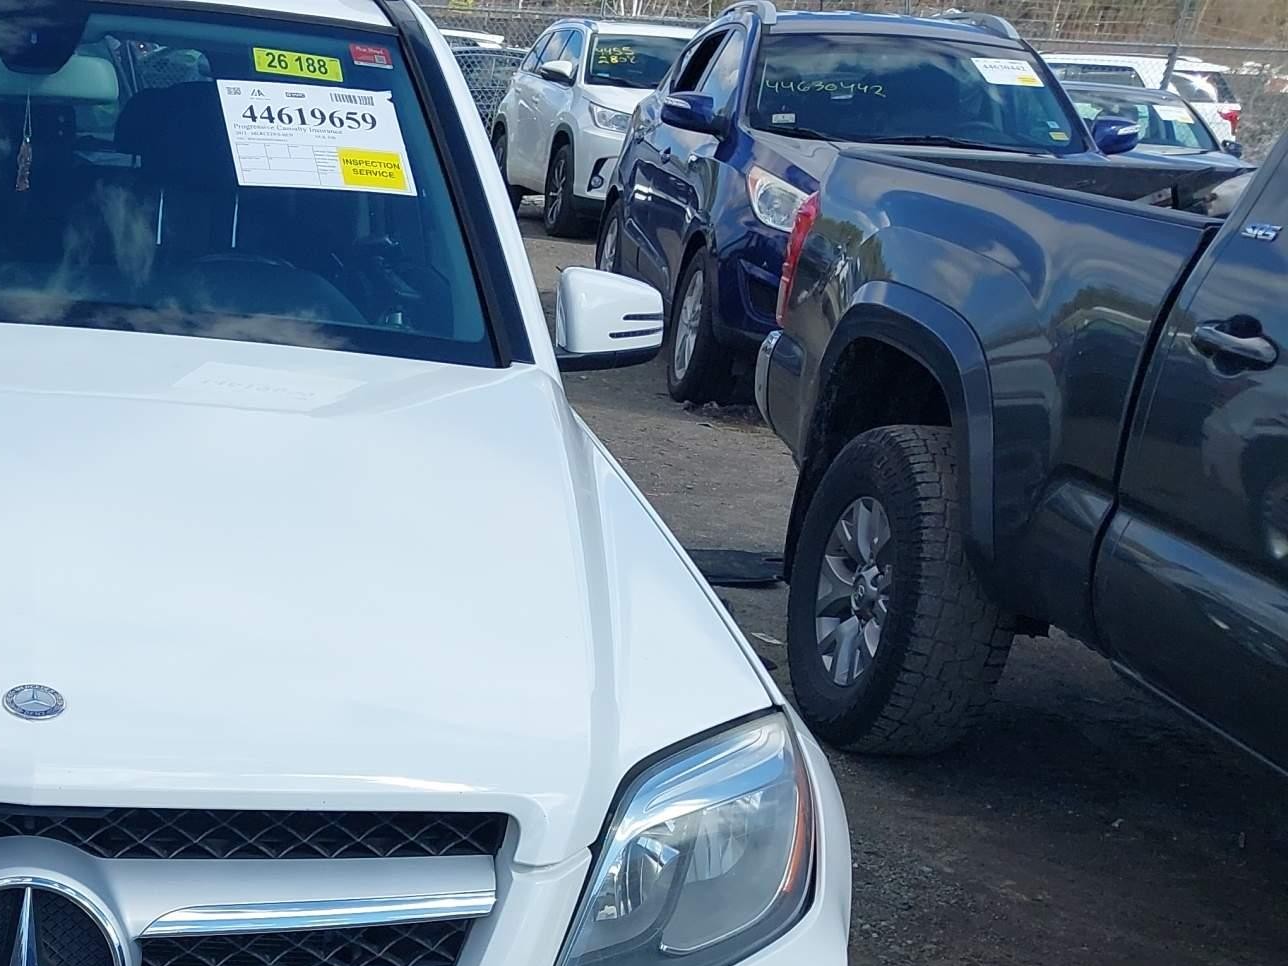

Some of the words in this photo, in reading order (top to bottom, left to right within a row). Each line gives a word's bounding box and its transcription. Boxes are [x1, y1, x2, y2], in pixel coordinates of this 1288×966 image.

[266, 52, 289, 70] 26
[295, 56, 329, 75] 188
[765, 80, 887, 98] 44630442
[242, 104, 377, 131] 44619659
[342, 158, 401, 170] INSPECTION
[352, 168, 396, 179] SERVICE
